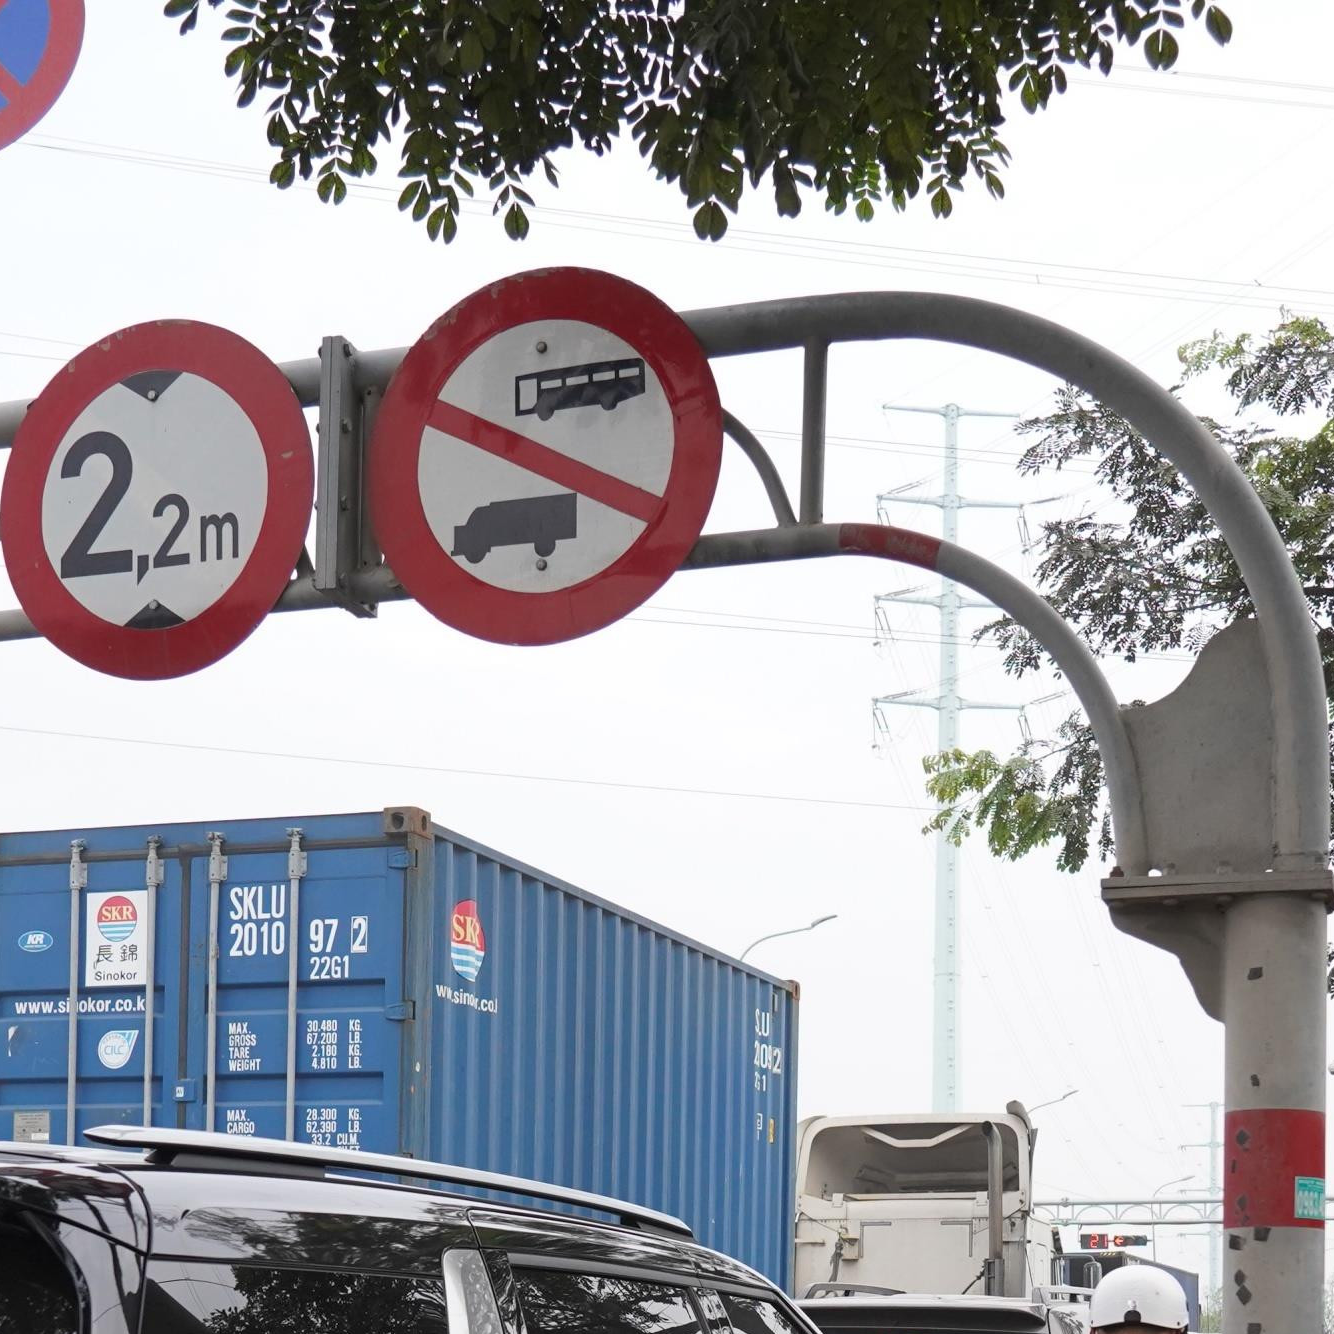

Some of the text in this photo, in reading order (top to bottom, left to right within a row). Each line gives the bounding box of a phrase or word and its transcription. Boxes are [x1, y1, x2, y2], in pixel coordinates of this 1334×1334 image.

[230, 885, 286, 920] SKLU
[101, 905, 133, 921] SKR
[229, 916, 368, 957] 2010 97 2
[309, 955, 349, 980] 22G1
[95, 970, 137, 981] Sinokor
[228, 1019, 362, 1034] MAX. 30.480 KG.
[229, 1032, 362, 1047] GROSS 67.200 LB.
[229, 1044, 362, 1059] TARE 2.180 KG.
[229, 1056, 362, 1072] WEIGHT 4.810 LB.
[227, 1108, 362, 1122] MAX. 28.300 KG.
[227, 1121, 362, 1134] CARGO 62.390 LB.
[312, 1133, 331, 1146] 33.2
